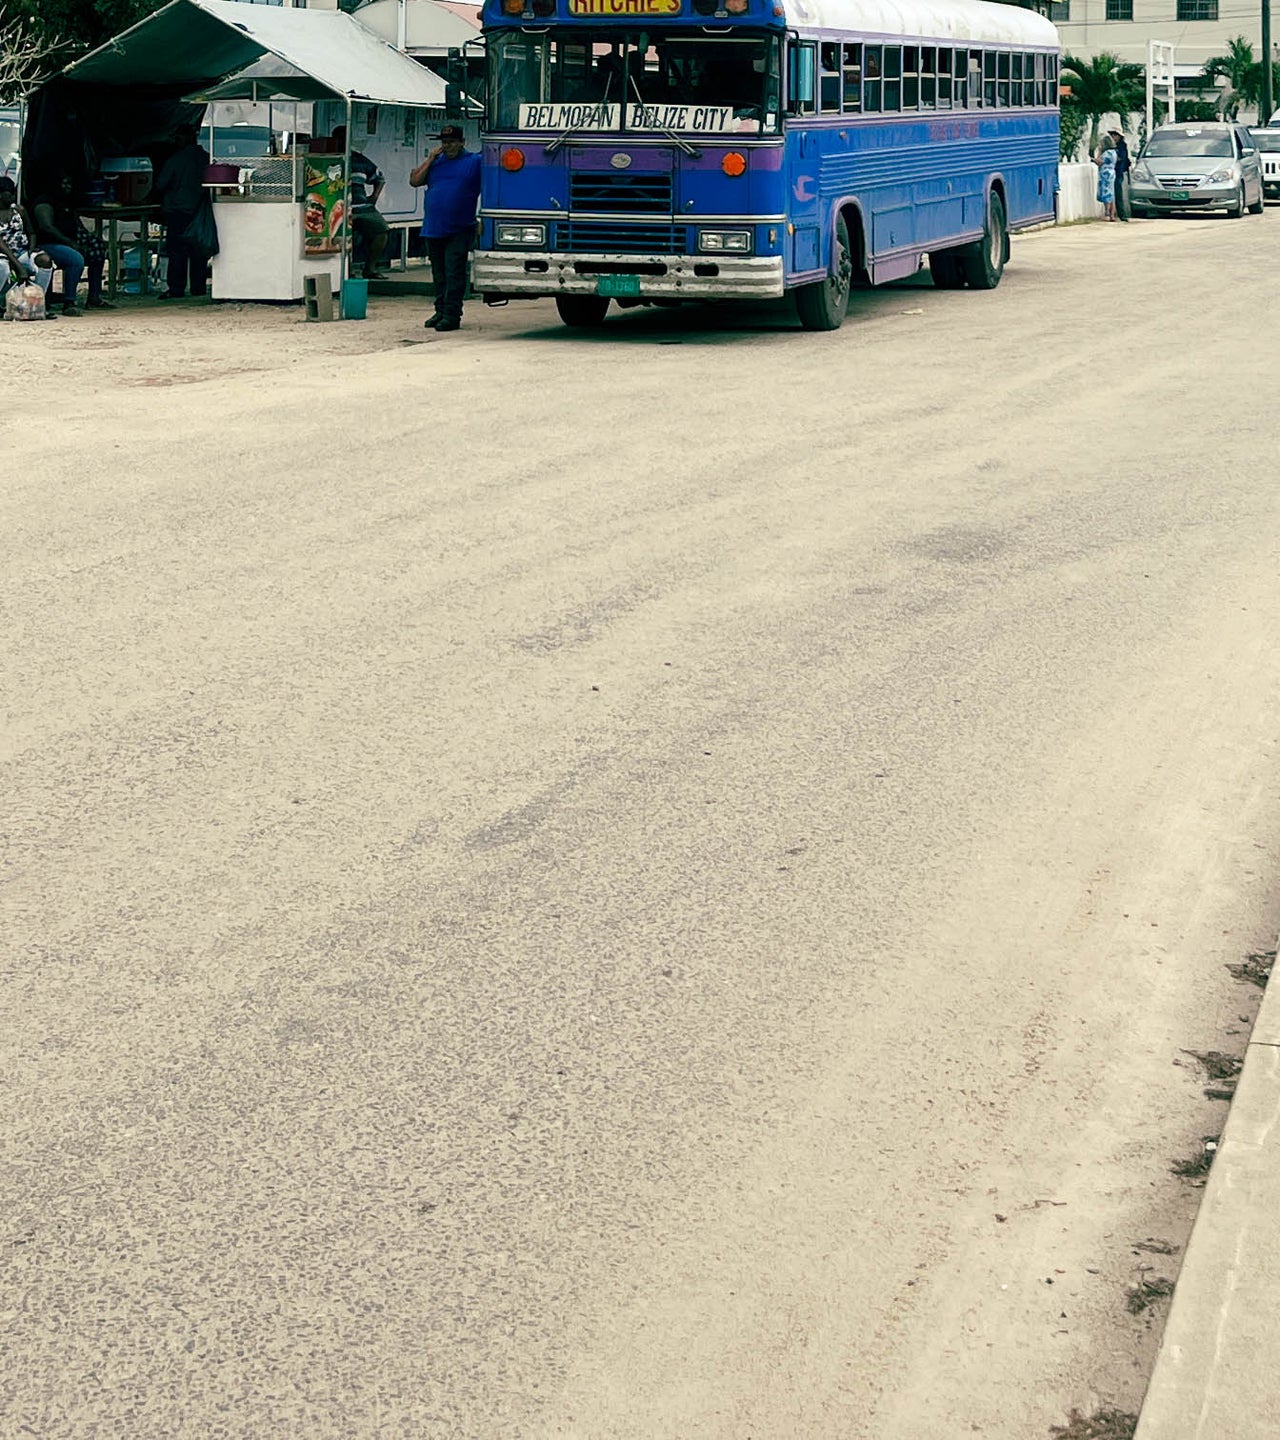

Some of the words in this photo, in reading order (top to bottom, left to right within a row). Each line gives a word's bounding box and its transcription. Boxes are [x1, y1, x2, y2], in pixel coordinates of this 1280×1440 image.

[524, 106, 615, 129] BELMOPAN
[630, 107, 688, 130] BELIZE
[691, 108, 730, 131] CITY
